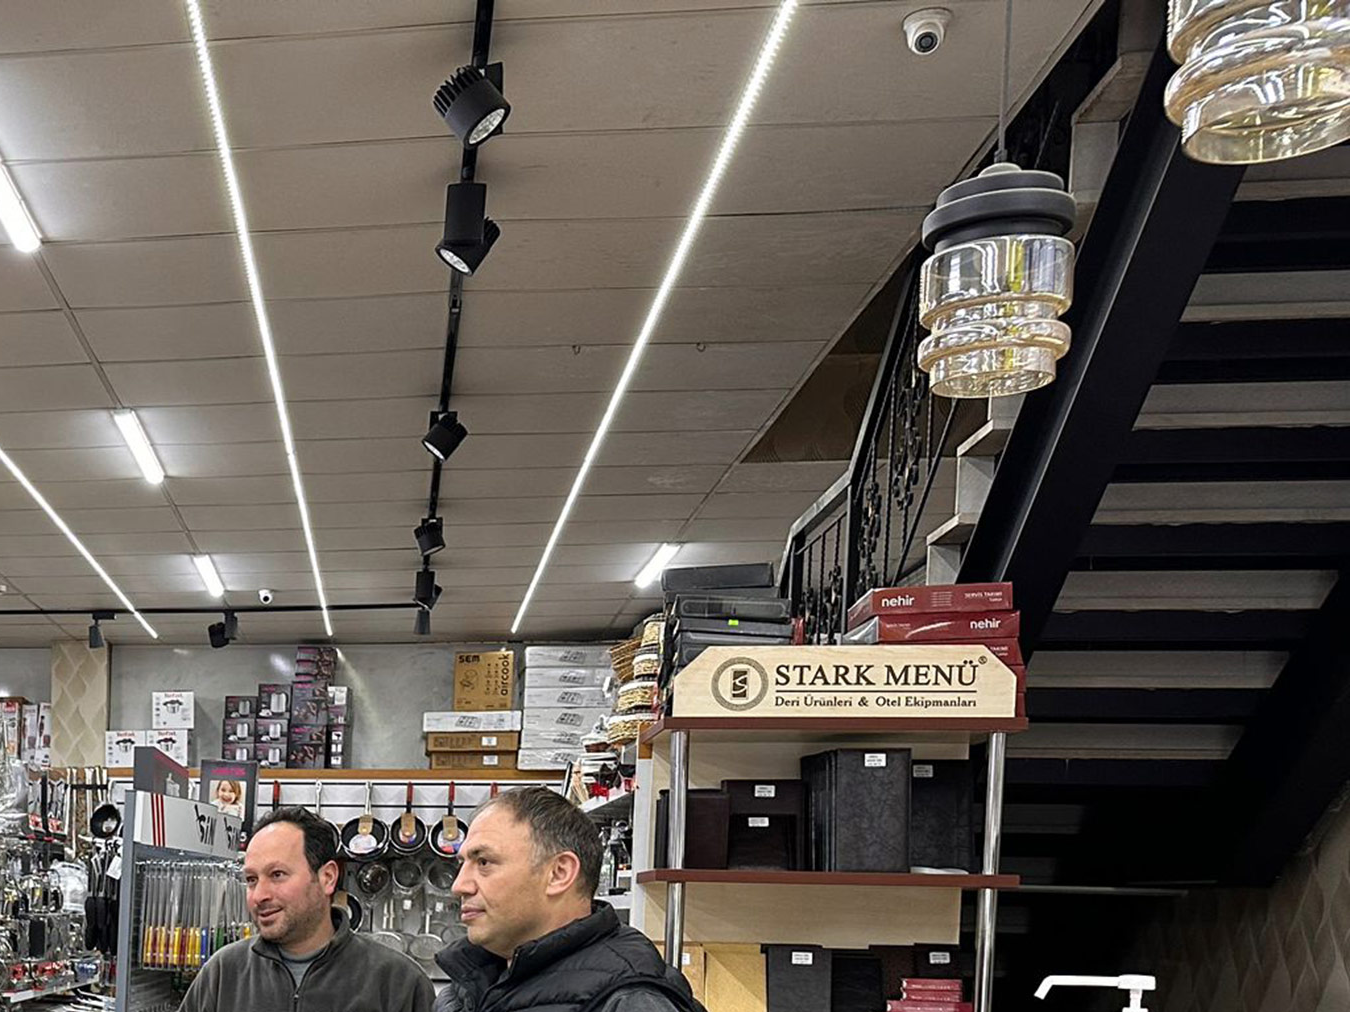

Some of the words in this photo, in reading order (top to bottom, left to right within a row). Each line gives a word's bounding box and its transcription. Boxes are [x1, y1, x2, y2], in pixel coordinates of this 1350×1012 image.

[881, 594, 915, 608] nehir
[970, 618, 1001, 629] nehir
[458, 655, 480, 664] SEM
[498, 653, 510, 696] aircook
[775, 664, 876, 686] STARK
[884, 660, 979, 687] MENÜ
[775, 696, 800, 708] Deri
[804, 694, 853, 708] Ürünleri
[858, 697, 869, 708] &
[875, 696, 901, 708] Otel
[905, 696, 977, 709] Ekipmanları
